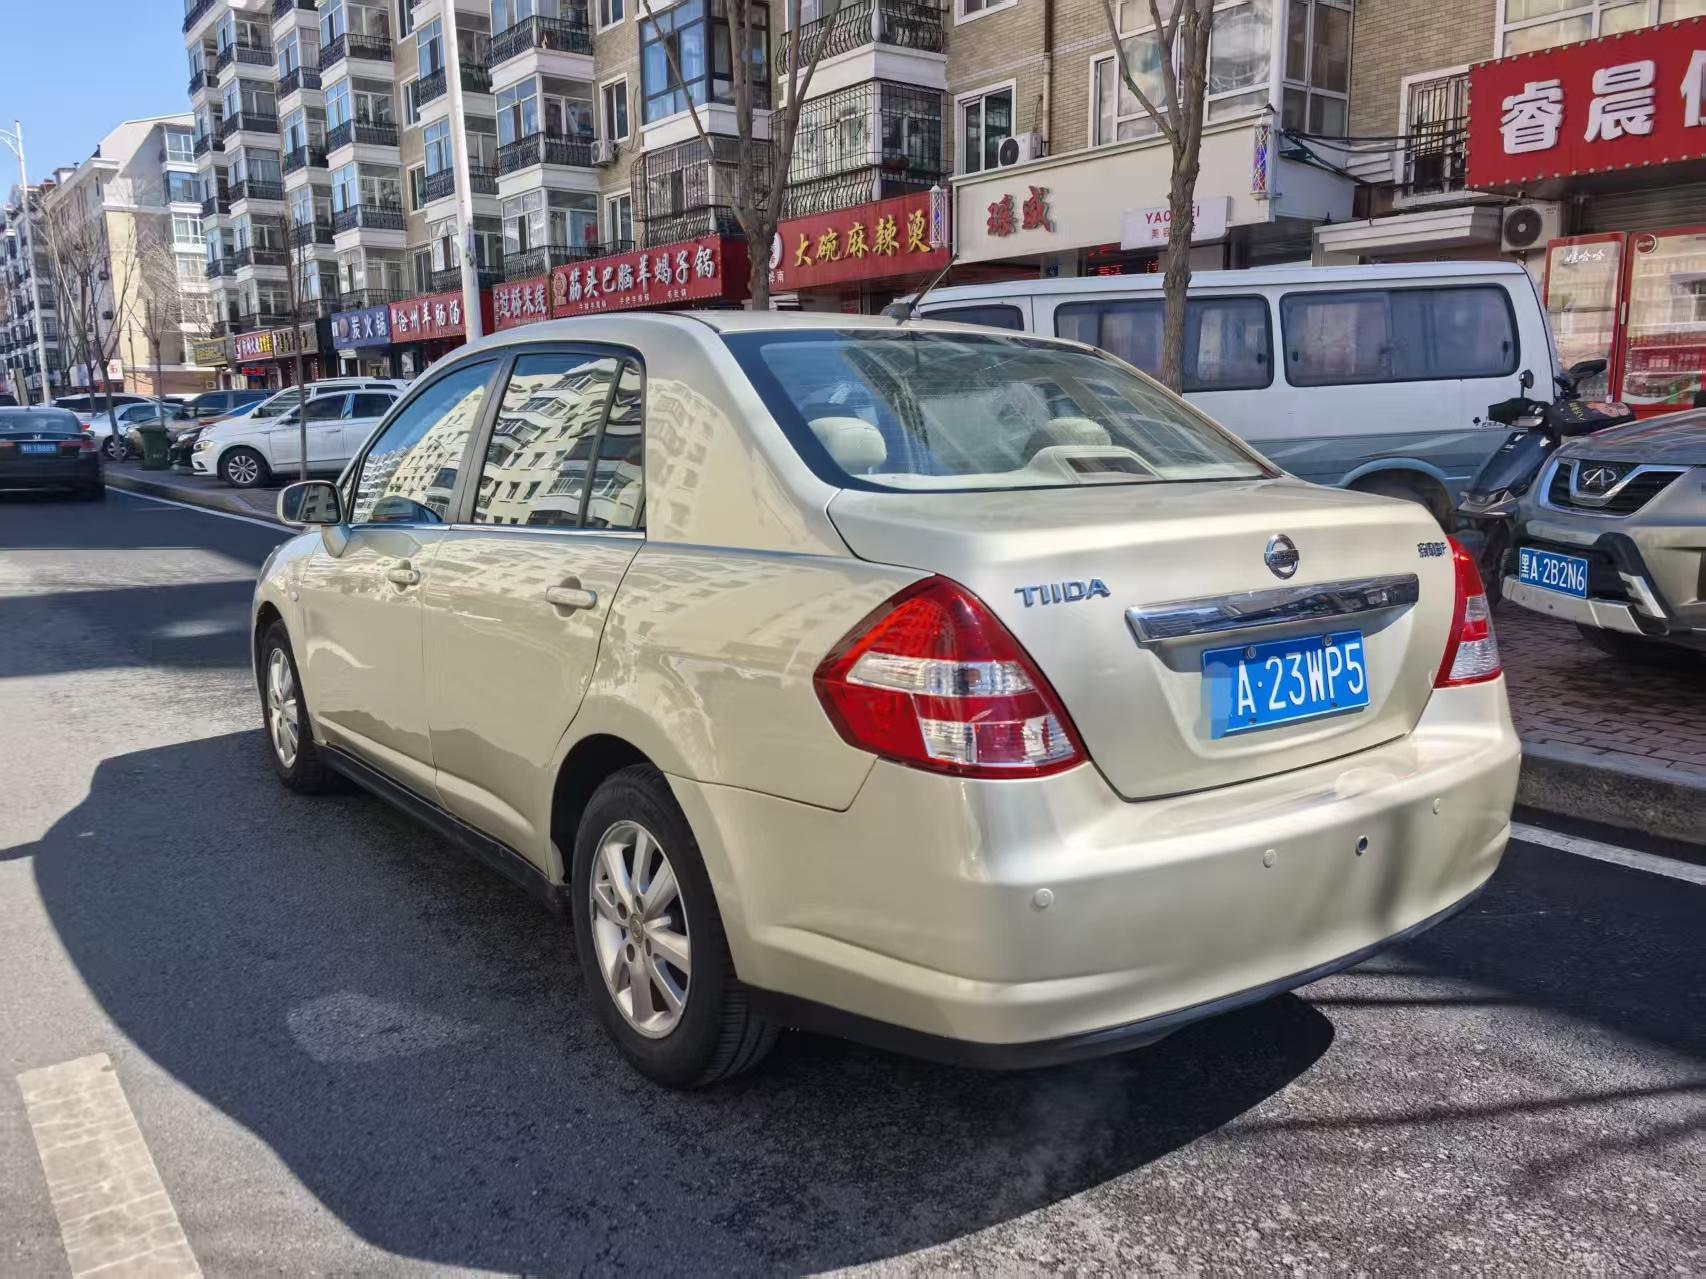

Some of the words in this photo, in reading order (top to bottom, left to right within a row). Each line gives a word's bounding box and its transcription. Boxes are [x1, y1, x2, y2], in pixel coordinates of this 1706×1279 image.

[794, 208, 931, 267] 大碗麻辣烫
[569, 245, 716, 302] 筋头巴脑羊蝎子锅
[351, 311, 388, 340] 炭火锅
[1014, 578, 1111, 608] TIIDA
